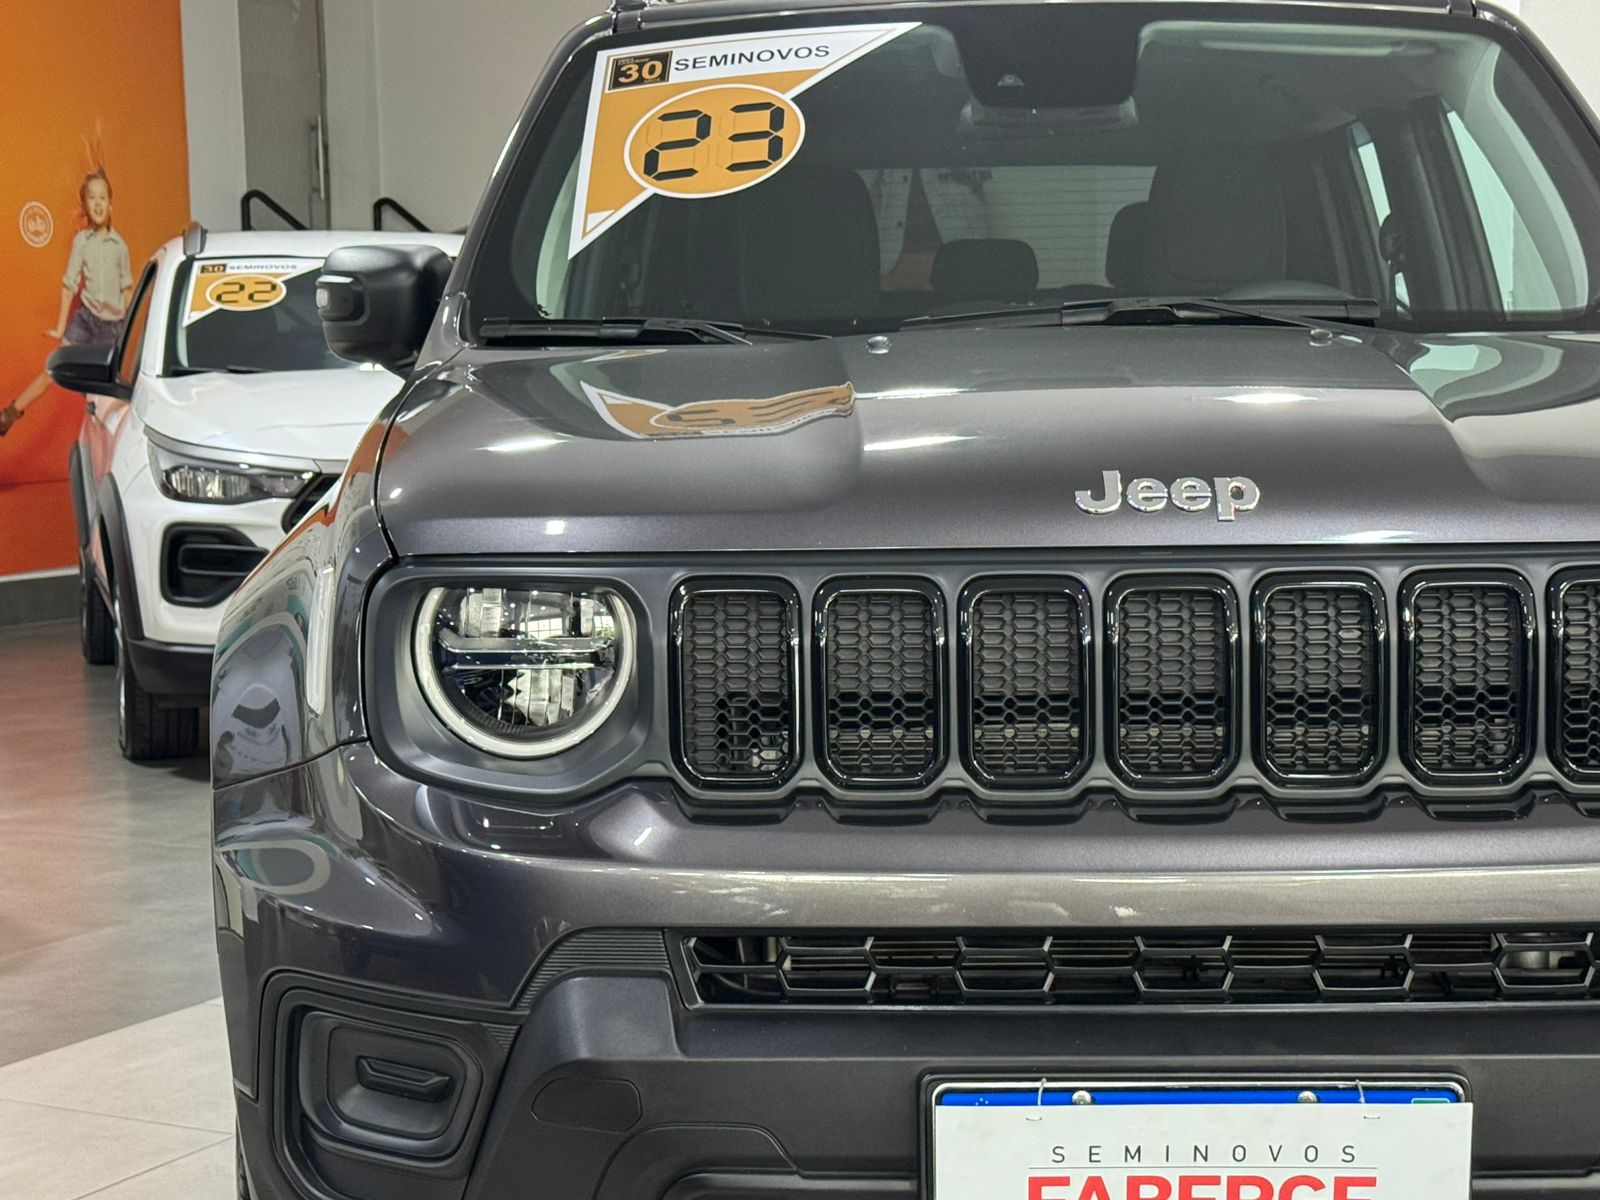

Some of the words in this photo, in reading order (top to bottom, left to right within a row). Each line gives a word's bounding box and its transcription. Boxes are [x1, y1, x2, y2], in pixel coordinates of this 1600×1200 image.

[618, 60, 663, 84] 30
[674, 45, 831, 72] SEMINOVOS
[643, 101, 785, 182] 23
[215, 281, 278, 304] 22
[1074, 469, 1261, 522] Jeep
[1051, 1144, 1356, 1164] SEMINOVOS
